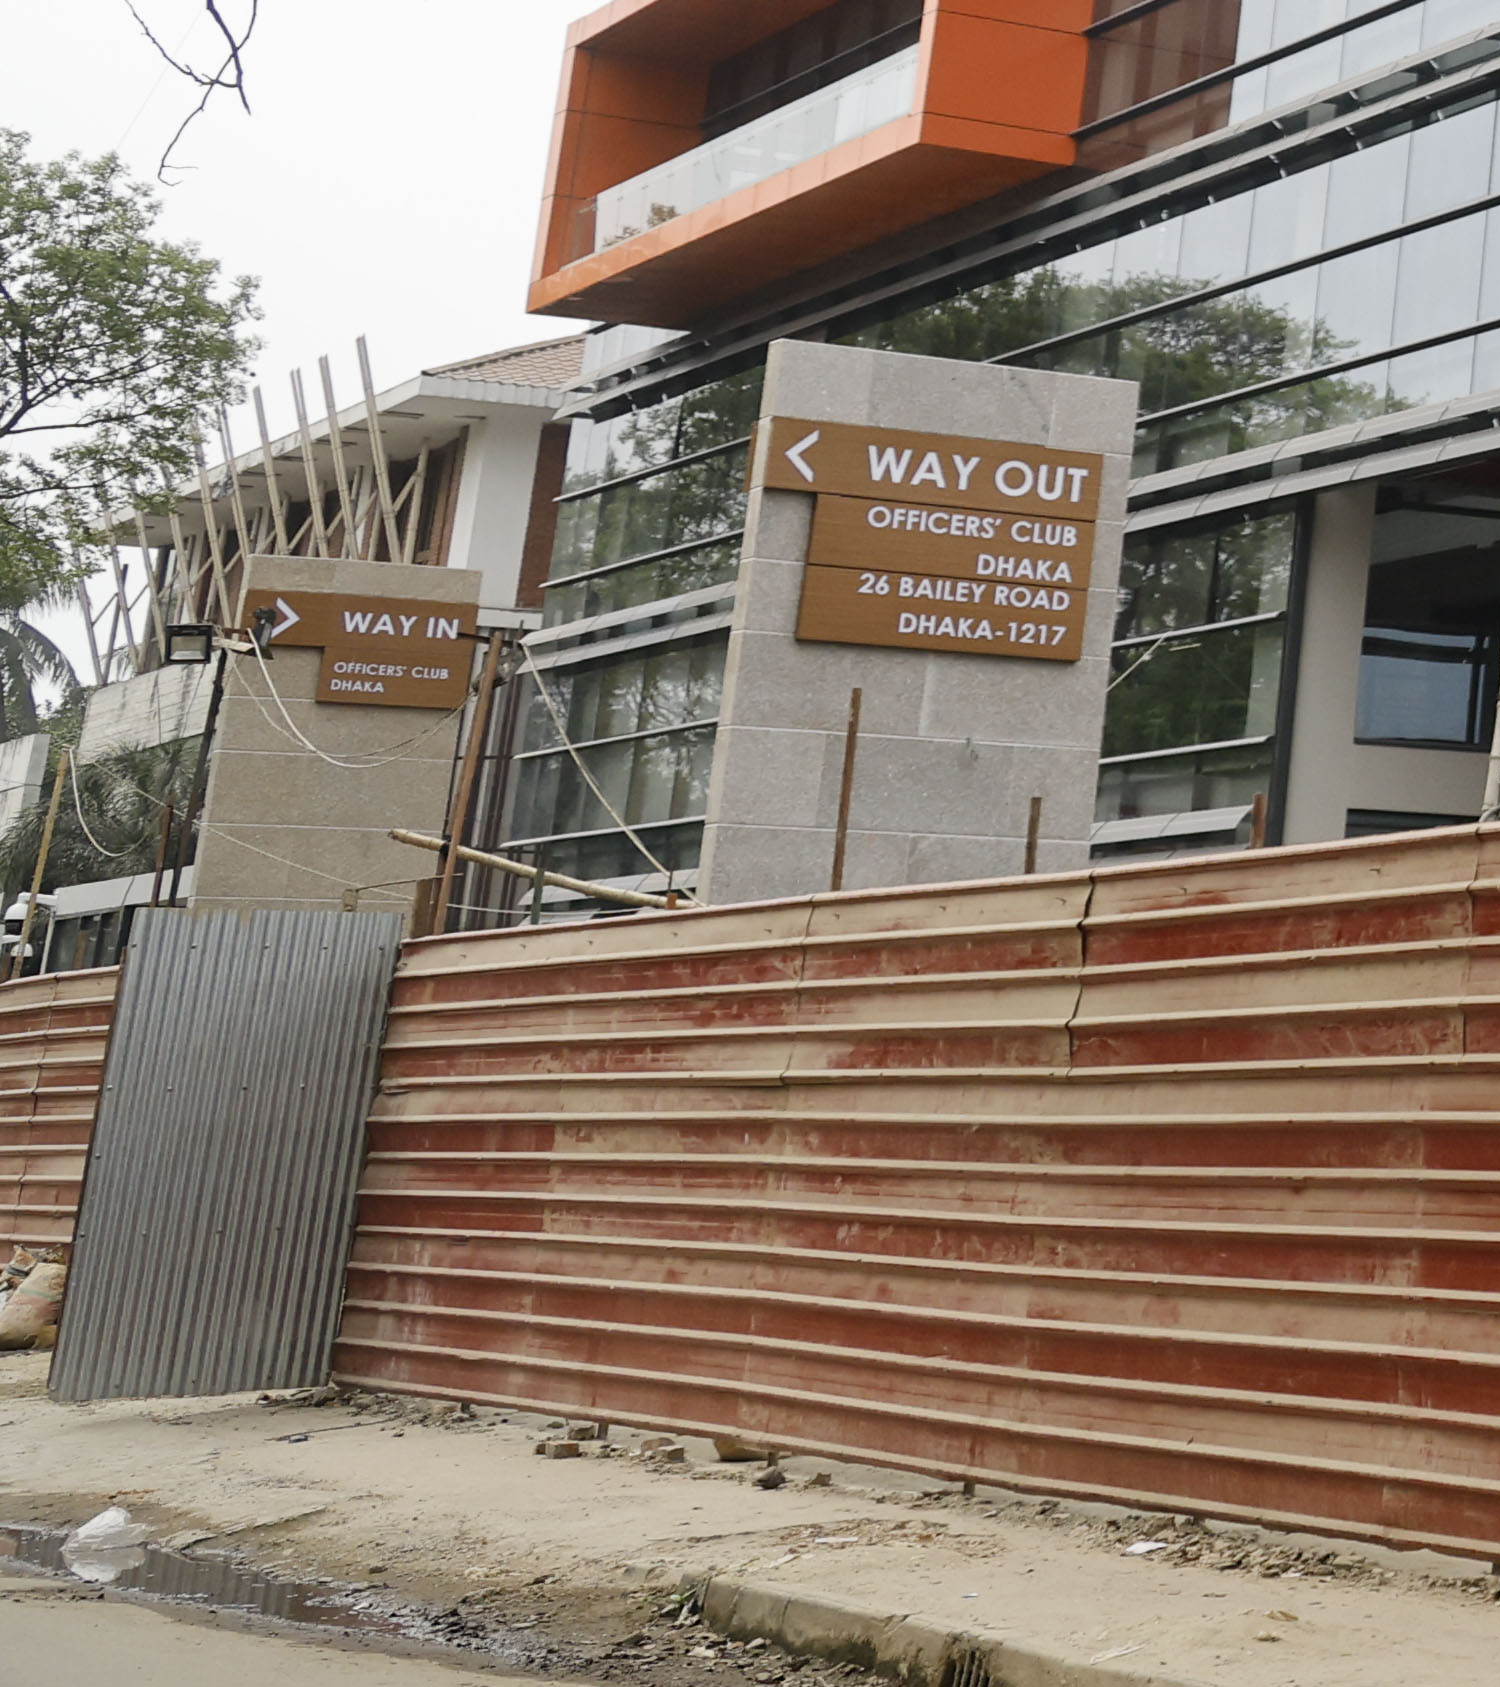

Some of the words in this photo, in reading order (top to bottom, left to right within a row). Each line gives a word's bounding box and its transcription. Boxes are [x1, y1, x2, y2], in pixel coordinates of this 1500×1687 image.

[867, 444, 981, 491] WAY
[994, 460, 1089, 503] OUT
[867, 505, 1001, 539] OFFICERS'
[1010, 520, 1079, 547] CLUB
[976, 553, 1073, 584] DHAKA
[857, 573, 891, 596] 26
[898, 576, 987, 604] BAILEY
[993, 586, 1071, 611] ROAD
[343, 611, 417, 636] WAY
[425, 616, 460, 640] IN
[897, 612, 1067, 646] DHAKA-1217
[330, 679, 385, 693] DHAKA
[411, 666, 449, 679] CLUB
